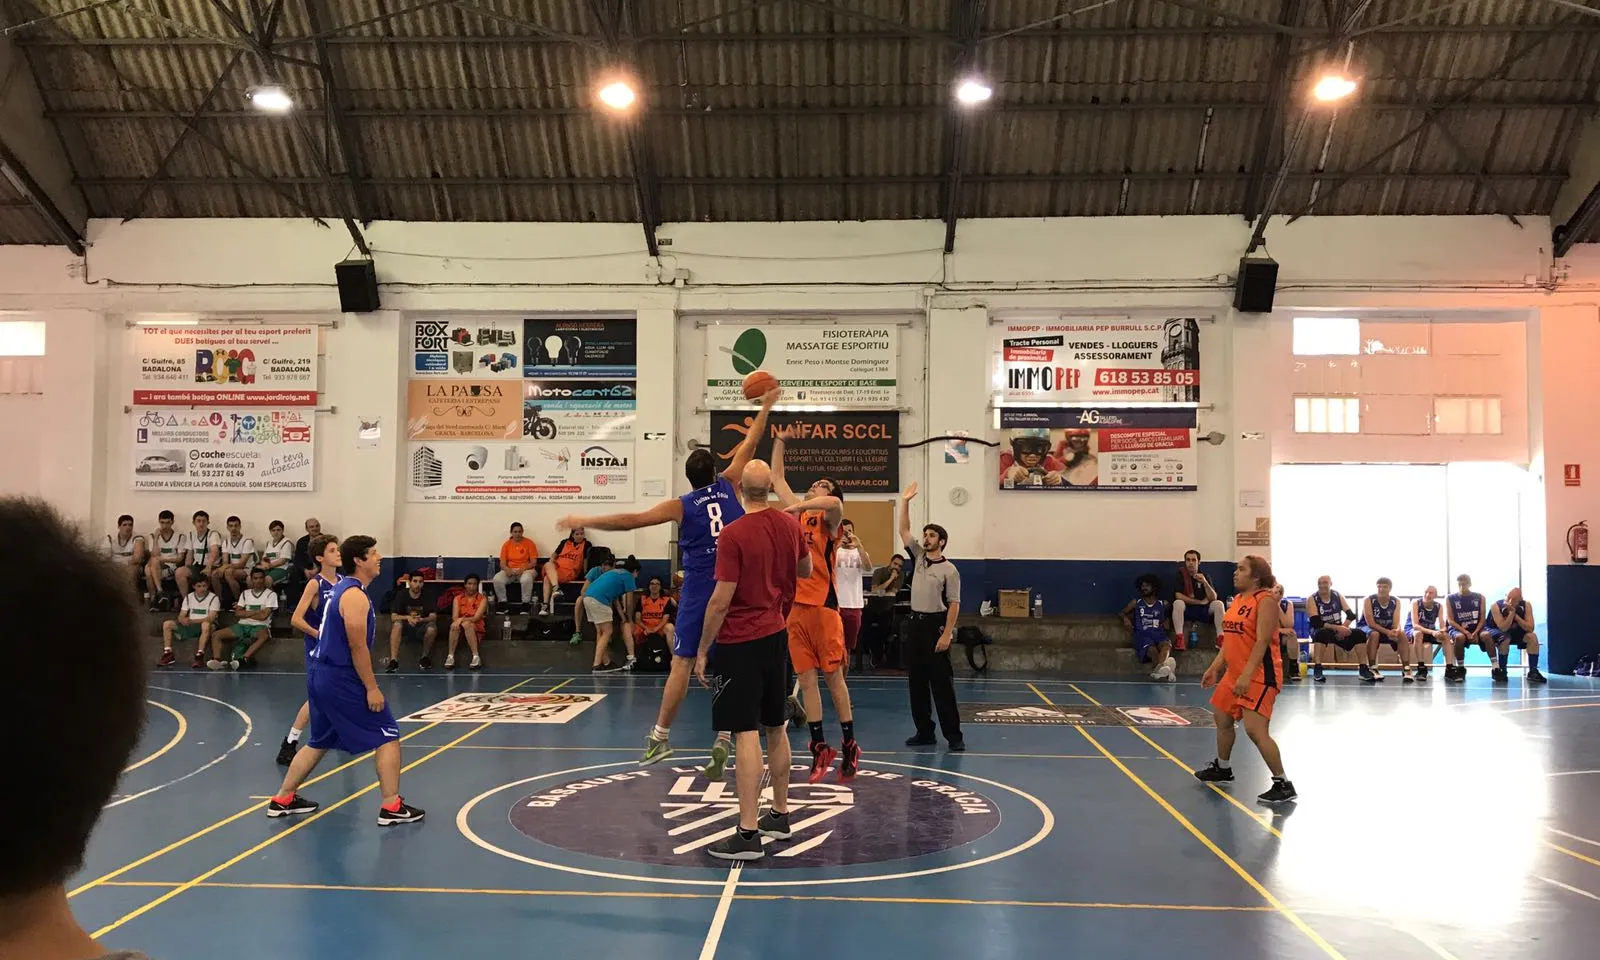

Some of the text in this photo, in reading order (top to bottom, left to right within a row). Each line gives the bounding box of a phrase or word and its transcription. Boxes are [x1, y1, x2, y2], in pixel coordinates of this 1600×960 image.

[260, 328, 281, 336] esport
[282, 328, 311, 336] preferit
[415, 321, 449, 336] BOX
[822, 329, 889, 339] FISIOTERÀPIA
[195, 338, 226, 346] botigues
[415, 337, 449, 352] FORT
[786, 342, 889, 350] MASSATGE ESPORTIU
[1111, 341, 1158, 349] LLOGUERS
[1074, 352, 1152, 360] ASSESSORAMENT
[1008, 366, 1081, 391] IMMOPEP
[1099, 371, 1194, 385] 618 53 85 05
[426, 385, 446, 397] LA
[1092, 387, 1159, 396] www.immopep.cat
[191, 394, 215, 402] botiga
[246, 394, 310, 402] www.jordiroig.net
[1079, 410, 1100, 424] AG
[770, 420, 892, 439] NAÏFAR SCCL
[271, 452, 304, 465] la teva
[261, 459, 310, 478] autoescola
[706, 502, 724, 537] 8
[1139, 607, 1145, 617] 9
[1237, 604, 1253, 619] 61
